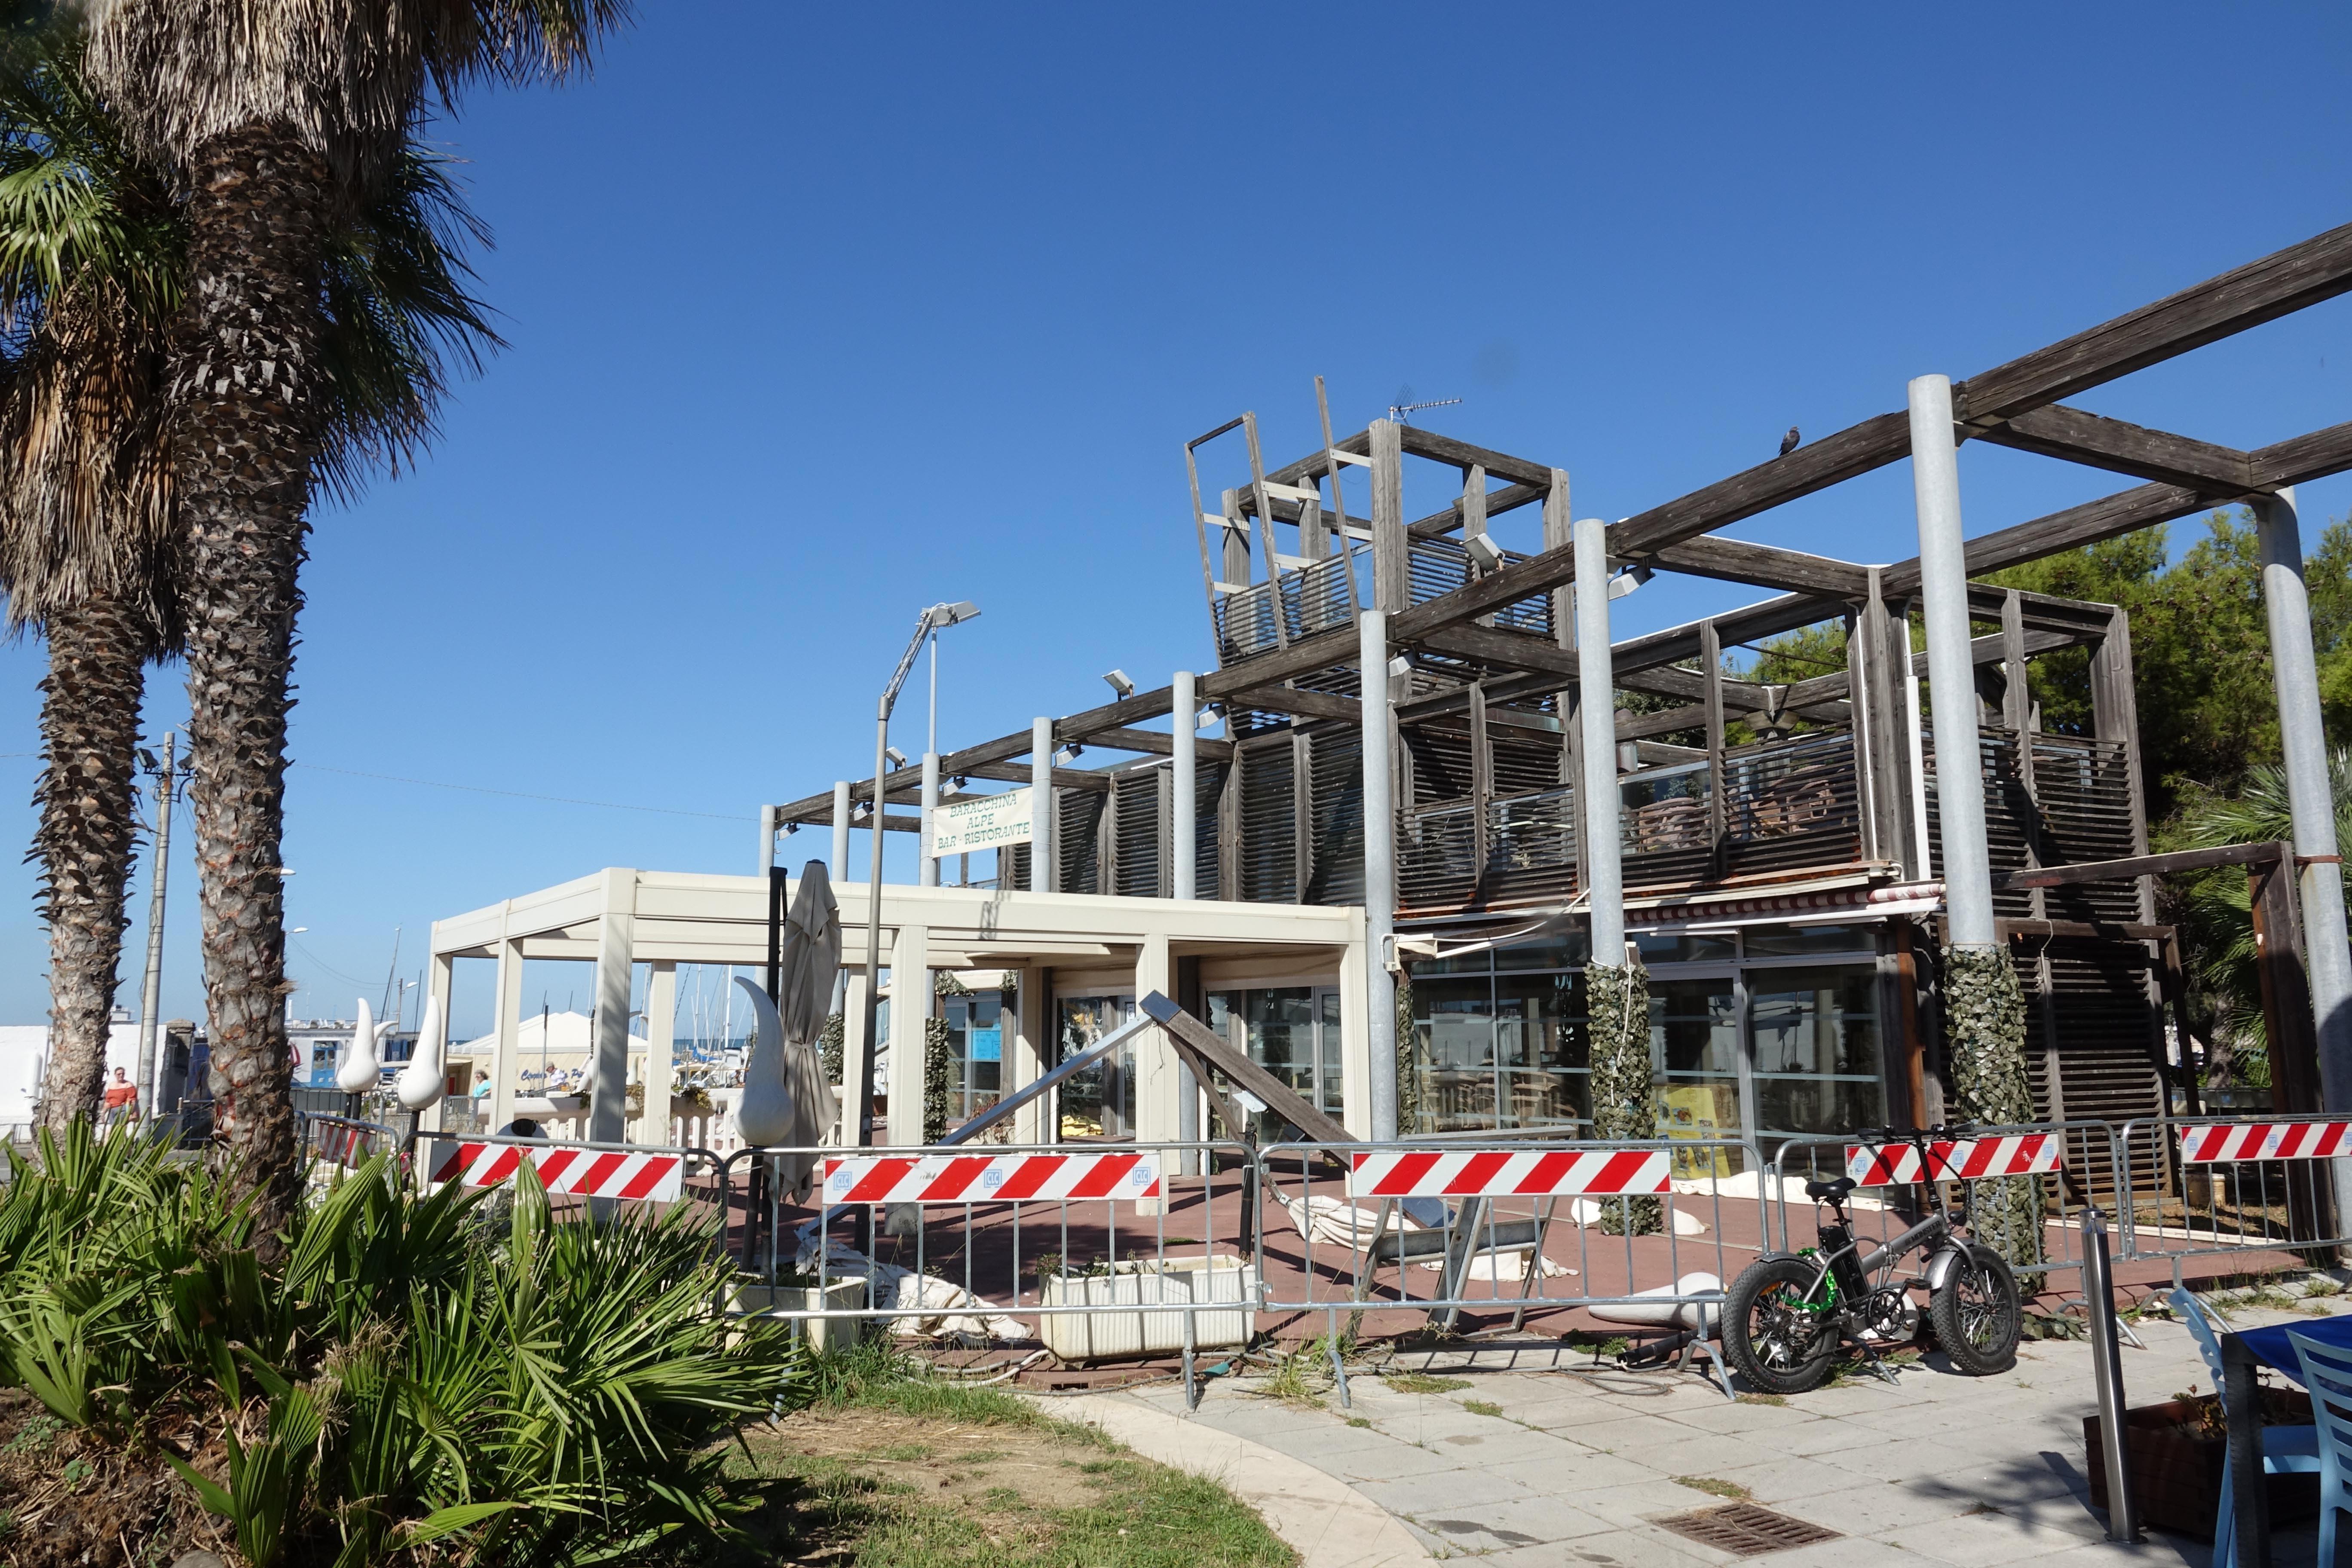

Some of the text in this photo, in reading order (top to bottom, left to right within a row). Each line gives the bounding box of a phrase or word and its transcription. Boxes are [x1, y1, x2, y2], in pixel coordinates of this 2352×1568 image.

[950, 793, 1017, 818] BARACCHINA
[967, 813, 994, 829] ALPE
[938, 836, 956, 849] BAR
[964, 821, 1030, 845] RISTORANTE
[836, 1175, 849, 1187] CLC
[986, 1172, 999, 1185] CLC
[1135, 1170, 1148, 1182] CLC
